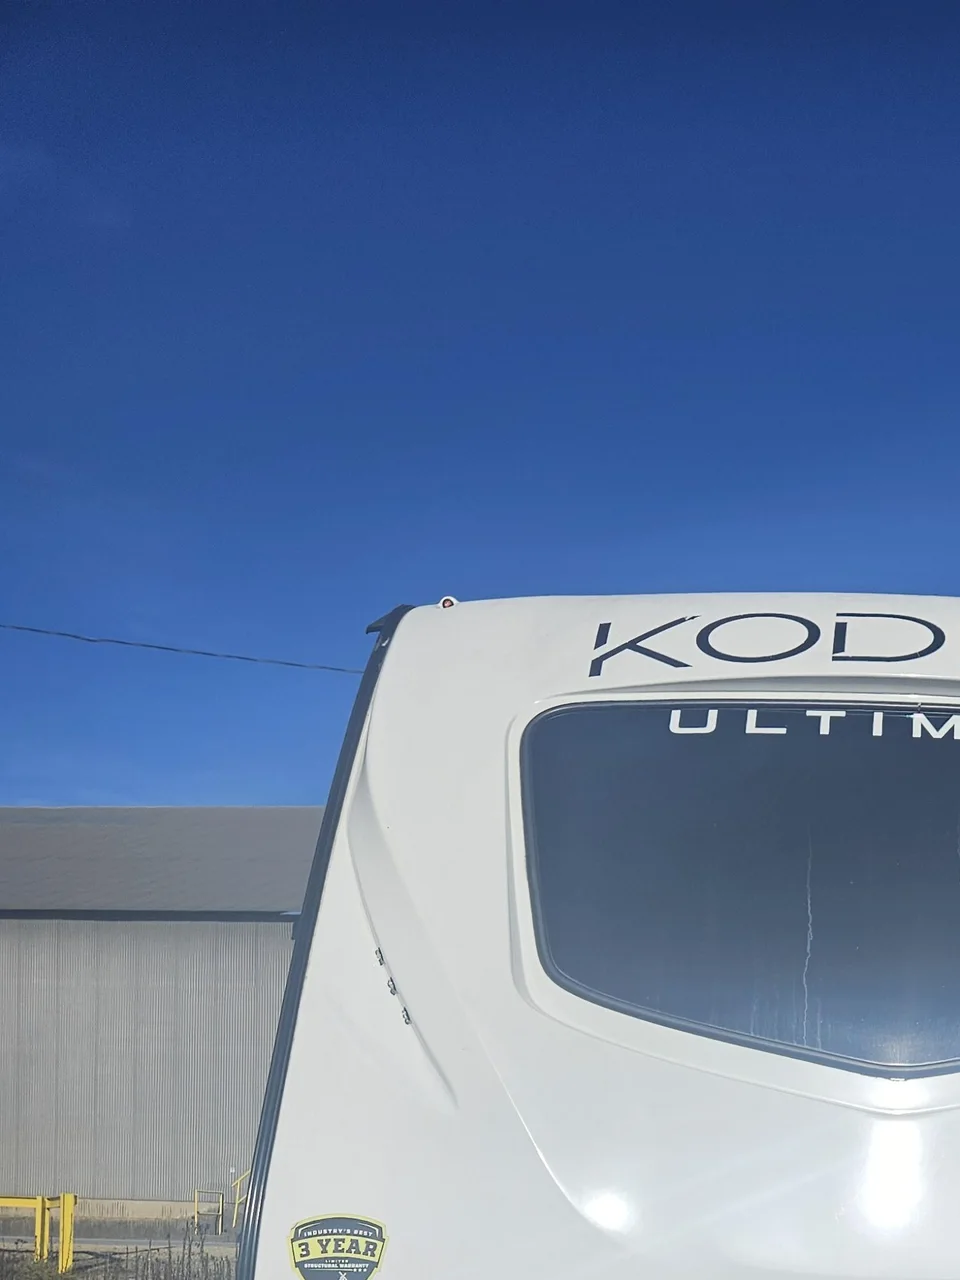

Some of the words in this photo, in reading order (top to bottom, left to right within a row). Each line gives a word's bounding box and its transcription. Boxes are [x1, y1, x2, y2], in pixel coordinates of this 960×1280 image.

[304, 1228, 351, 1237] INDUSTRY'S
[353, 1229, 373, 1237] BEST
[298, 1242, 310, 1258] 3
[316, 1238, 378, 1258] YEAR
